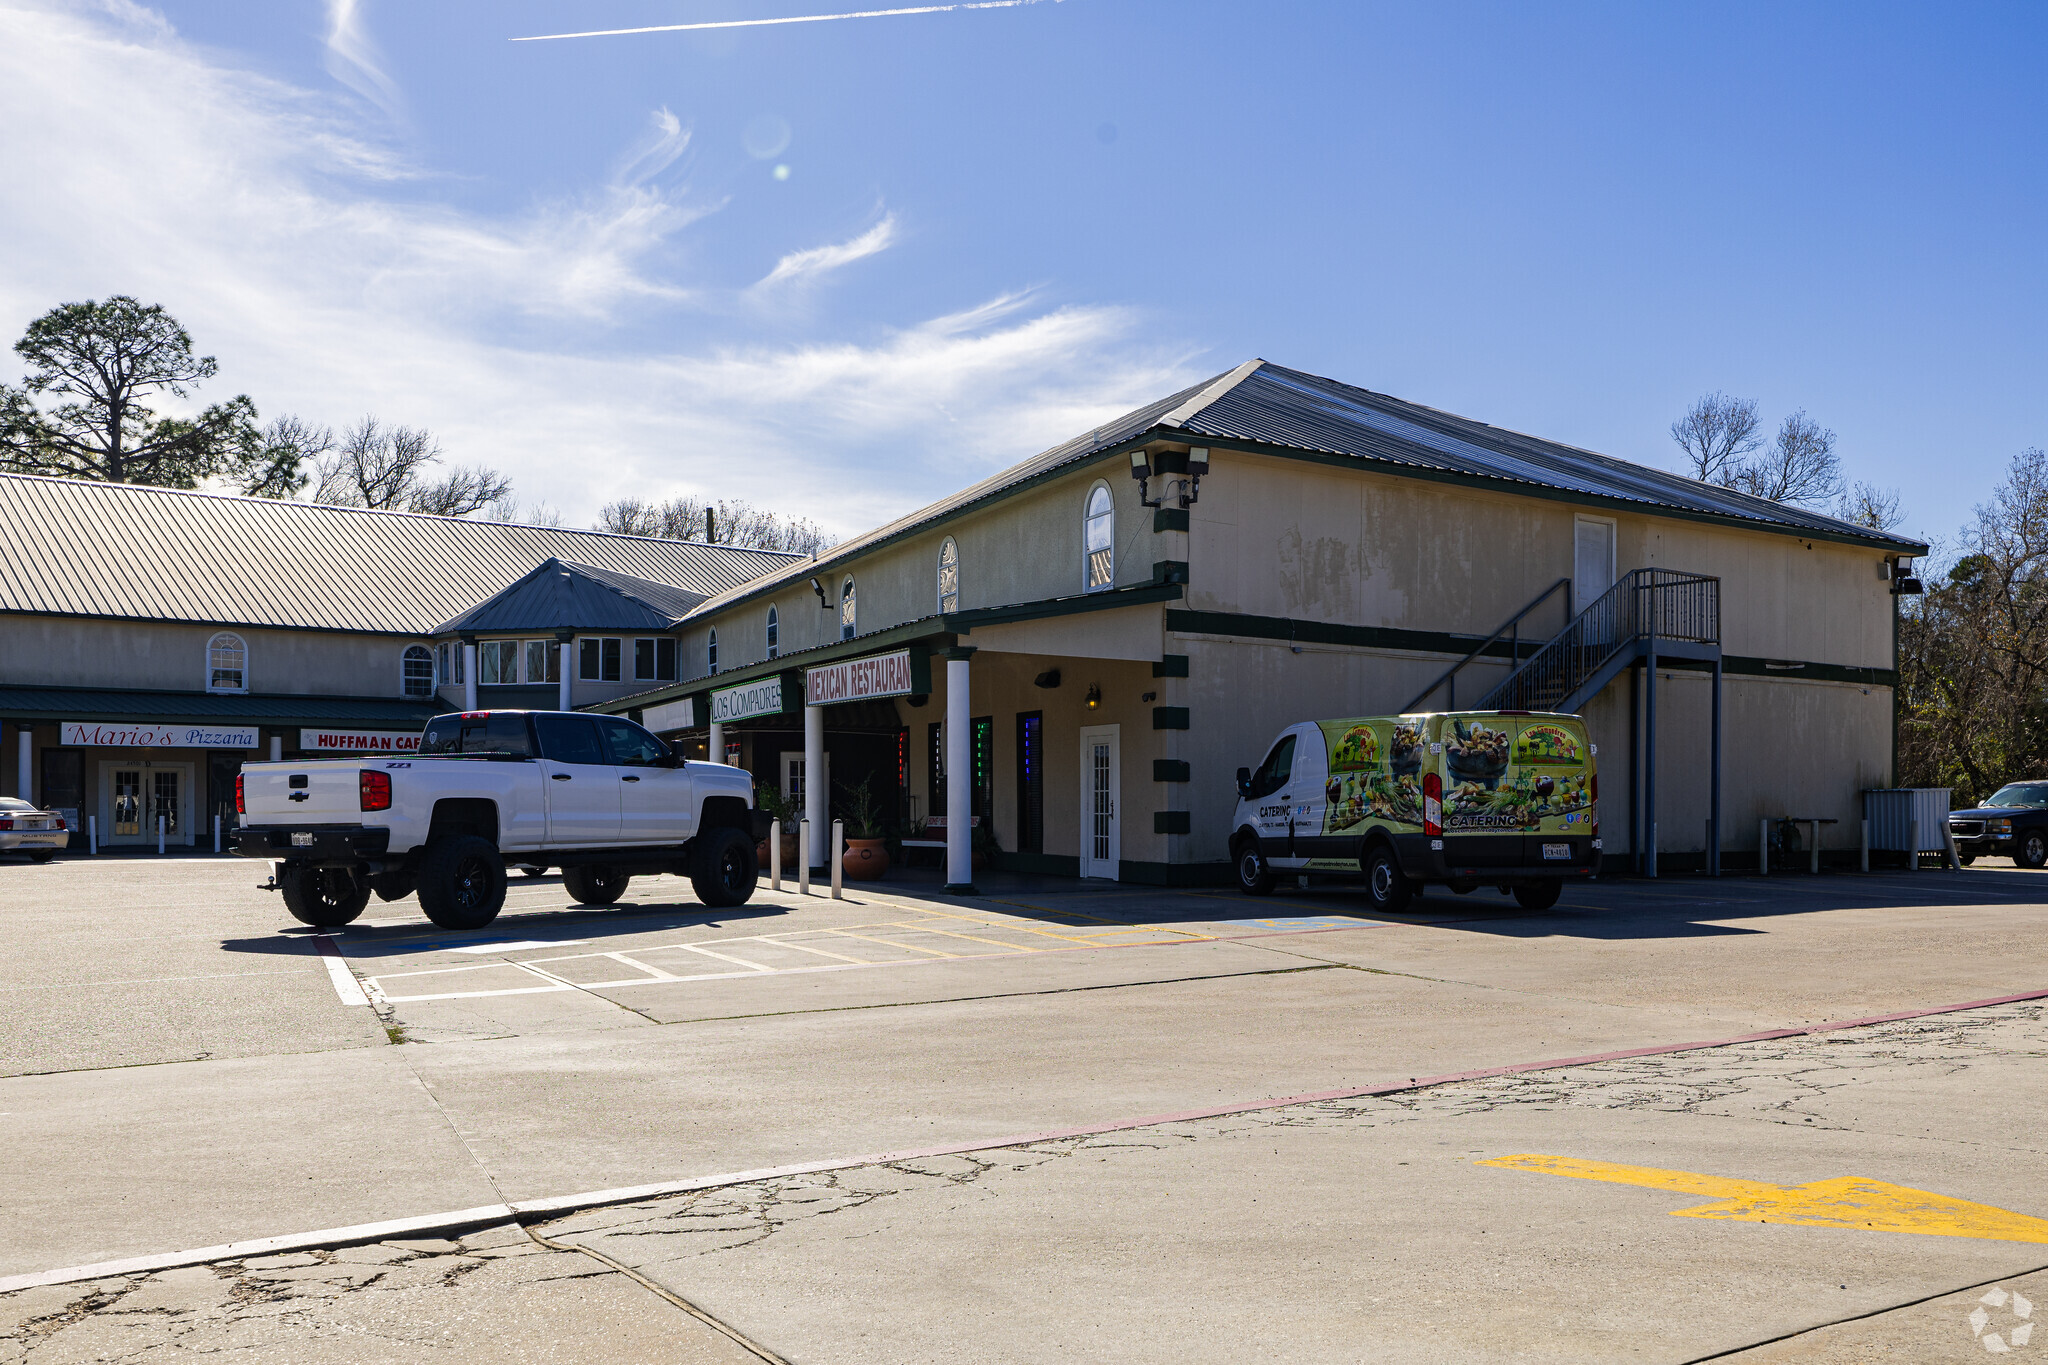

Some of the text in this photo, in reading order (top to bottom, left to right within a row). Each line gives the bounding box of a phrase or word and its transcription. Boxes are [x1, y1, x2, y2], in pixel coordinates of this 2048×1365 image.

[808, 667, 847, 702] MEXICAN
[713, 685, 781, 720] LOS COMPADRES
[68, 725, 252, 746] Mario's Pizzaria
[318, 734, 391, 750] HUFFMAN
[1260, 805, 1291, 817] CATERING
[1450, 815, 1517, 826] CATERING
